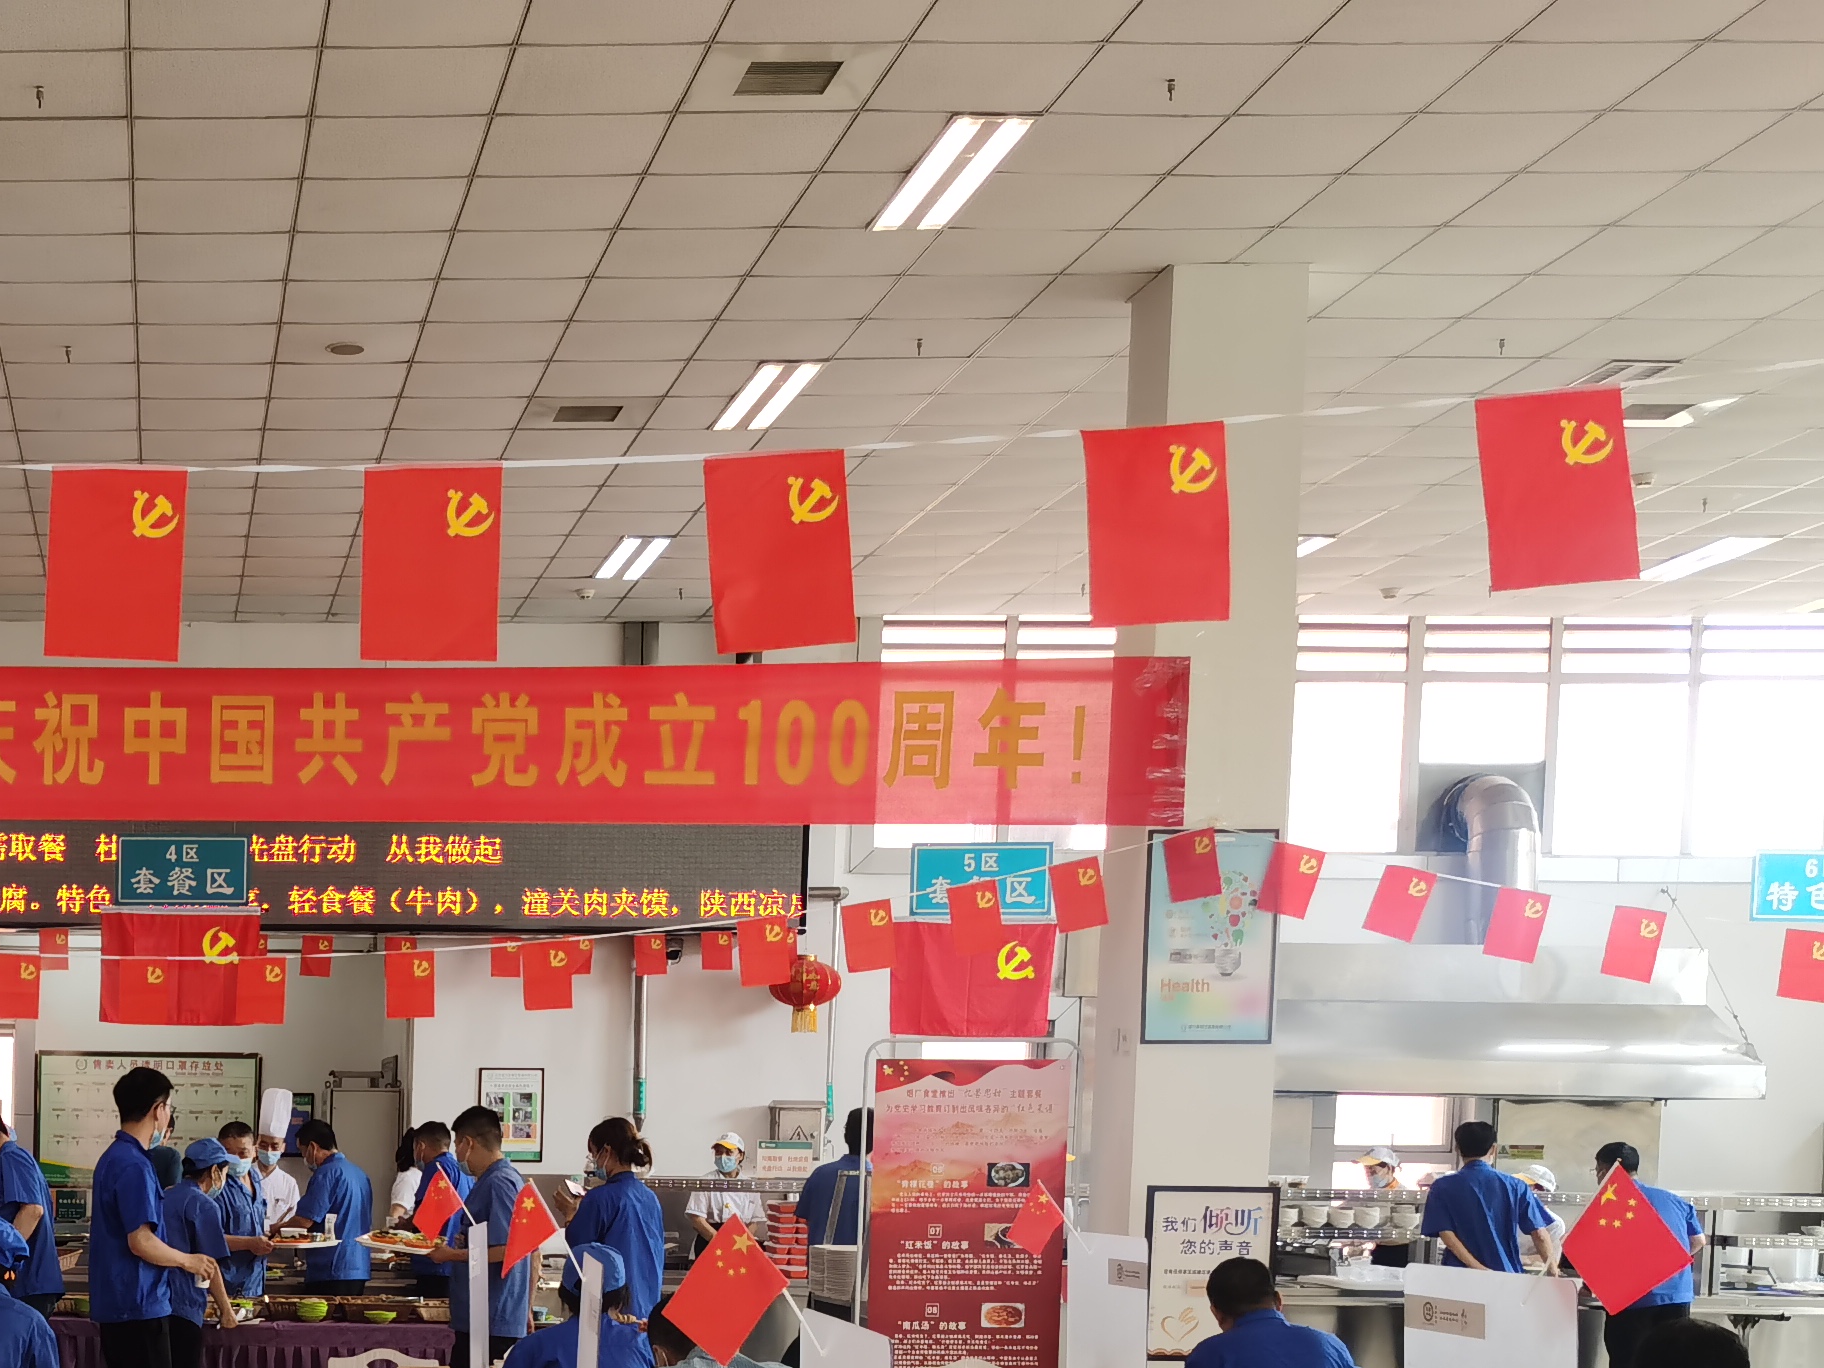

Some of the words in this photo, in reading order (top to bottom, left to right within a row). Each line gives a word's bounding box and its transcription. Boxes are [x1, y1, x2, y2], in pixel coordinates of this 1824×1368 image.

[166, 843, 200, 864] 4区
[385, 834, 504, 865] 从我做起
[963, 852, 1000, 873] 5区
[130, 867, 236, 897] 套餐区
[928, 875, 1036, 905] 套区
[1160, 977, 1211, 994] Health
[929, 1226, 941, 1235] 07
[1161, 1205, 1264, 1236] 我们倾听
[1180, 1238, 1253, 1256] 您的声音
